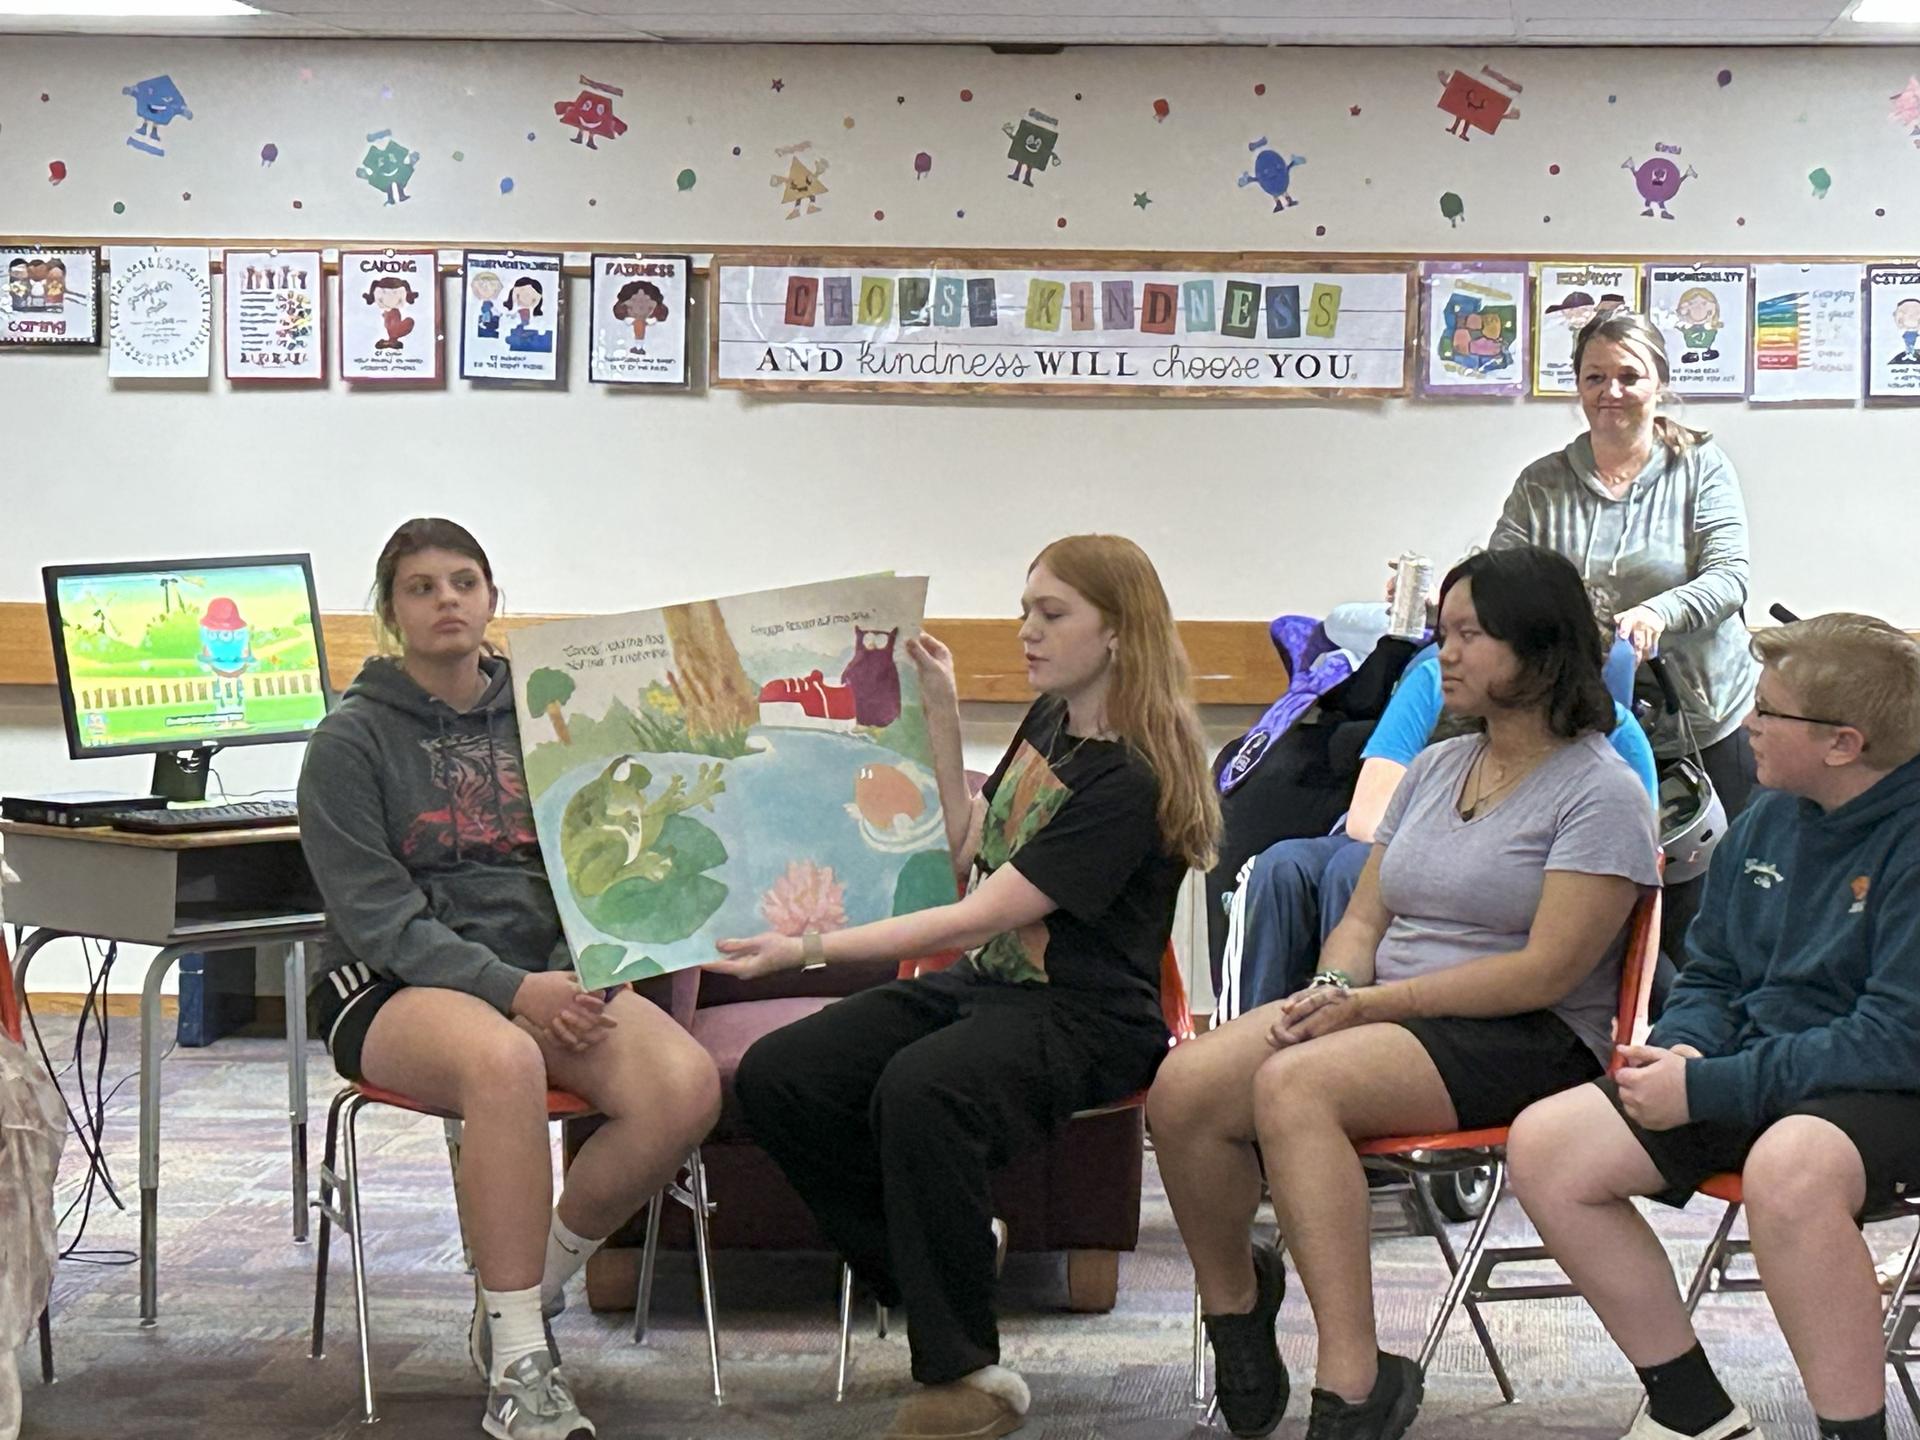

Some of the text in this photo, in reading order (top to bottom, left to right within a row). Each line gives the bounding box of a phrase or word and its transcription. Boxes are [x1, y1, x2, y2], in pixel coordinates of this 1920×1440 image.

[605, 263, 676, 277] FAIRNESS
[1653, 271, 1745, 283] SPOSIBILITY
[1035, 286, 1335, 331] KINDNESS
[756, 339, 1353, 380] AND kindness WILL choose YOU
